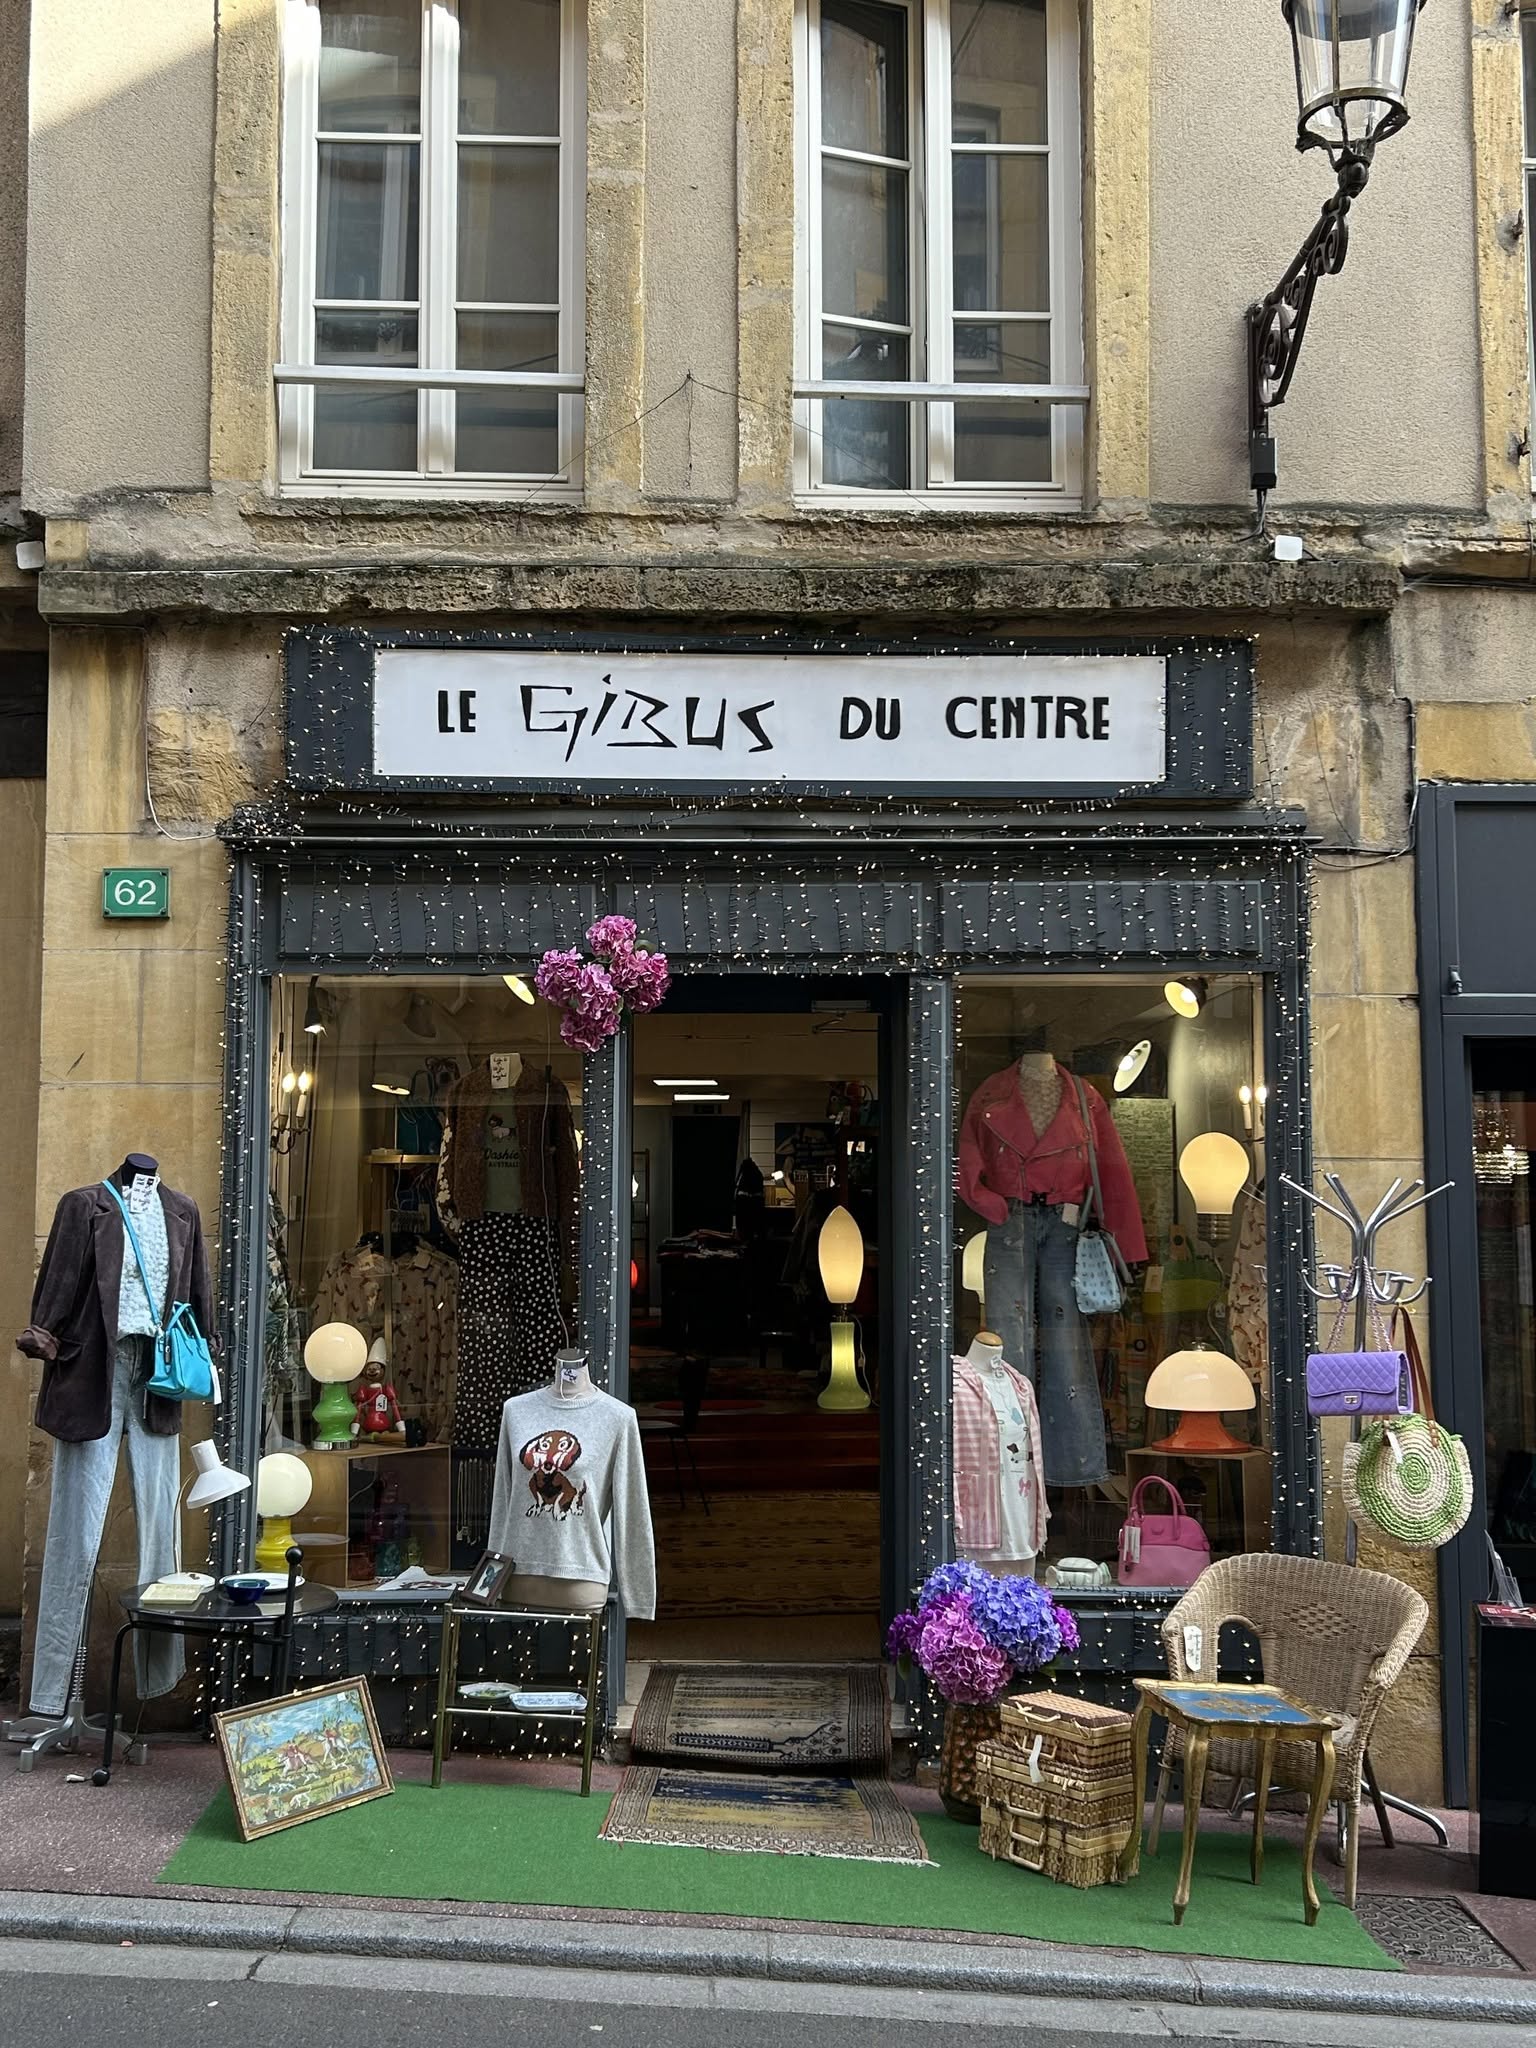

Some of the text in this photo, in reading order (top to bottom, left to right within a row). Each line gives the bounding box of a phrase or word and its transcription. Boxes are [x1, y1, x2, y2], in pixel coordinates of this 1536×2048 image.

[438, 690, 477, 733] LE
[839, 696, 901, 741] DU
[945, 695, 1110, 741] CENTRE
[114, 879, 157, 906] 62
